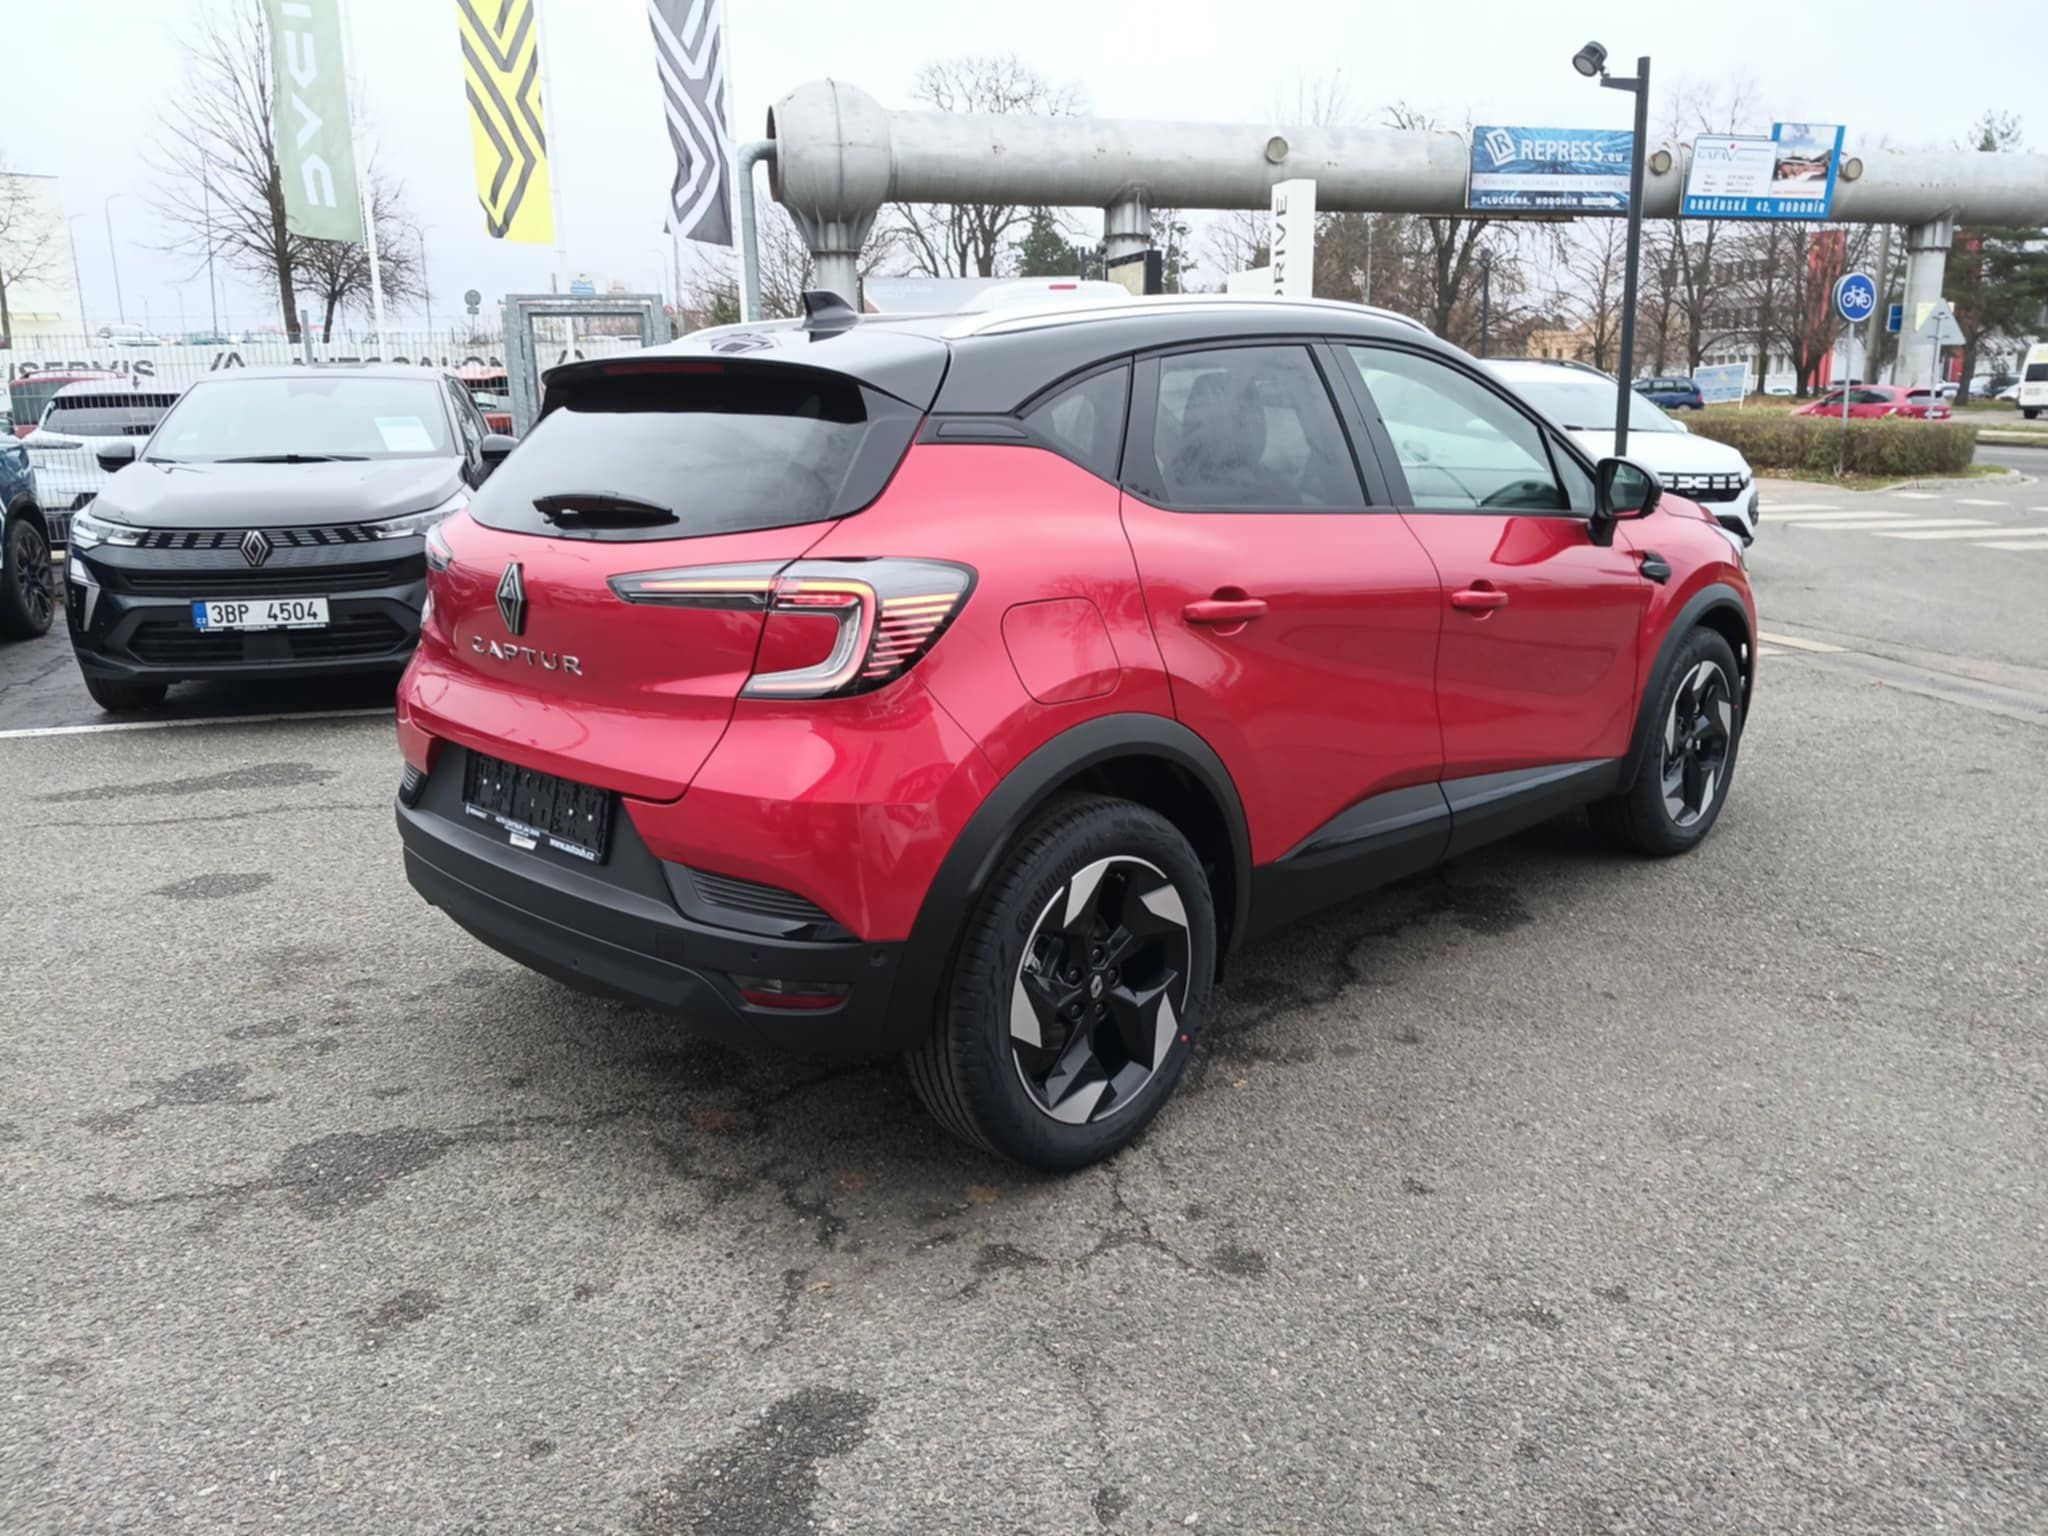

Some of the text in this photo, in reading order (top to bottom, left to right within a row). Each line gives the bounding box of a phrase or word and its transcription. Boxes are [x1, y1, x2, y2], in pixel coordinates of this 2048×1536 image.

[1520, 140, 1623, 163] REPRESS.eu
[1778, 200, 1826, 214] HODONÍN
[211, 601, 318, 623] 3BP 4504
[471, 635, 583, 677] CAPTUR
